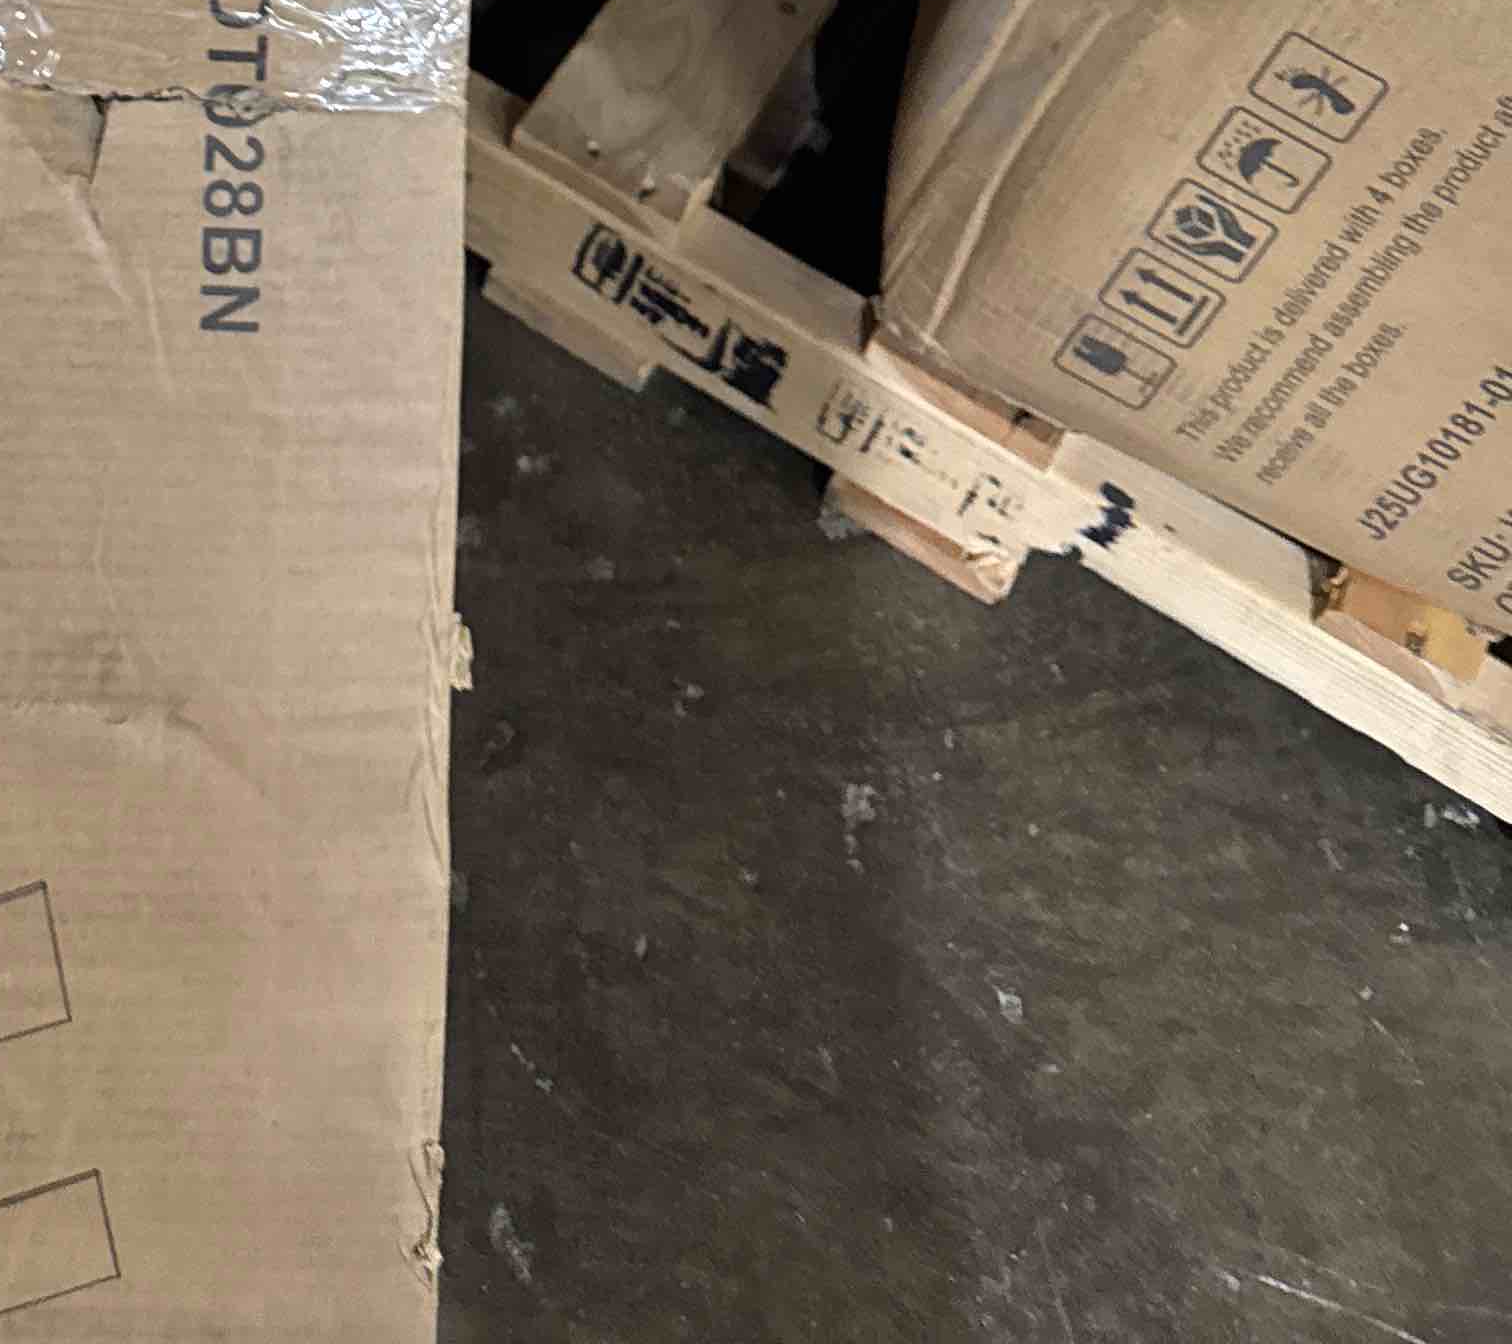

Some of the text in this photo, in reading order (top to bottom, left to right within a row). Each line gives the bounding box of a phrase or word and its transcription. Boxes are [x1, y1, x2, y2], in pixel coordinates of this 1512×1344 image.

[1176, 126, 1448, 442] This product is delivered with 4 boxes.
[1213, 431, 1246, 464] We
[1241, 332, 1335, 439] recommend
[1322, 232, 1423, 340] assembling
[1401, 199, 1444, 237] the
[1432, 123, 1506, 208] product
[1255, 321, 1408, 486] receive all the boxes.
[1446, 531, 1511, 593] SKU:
